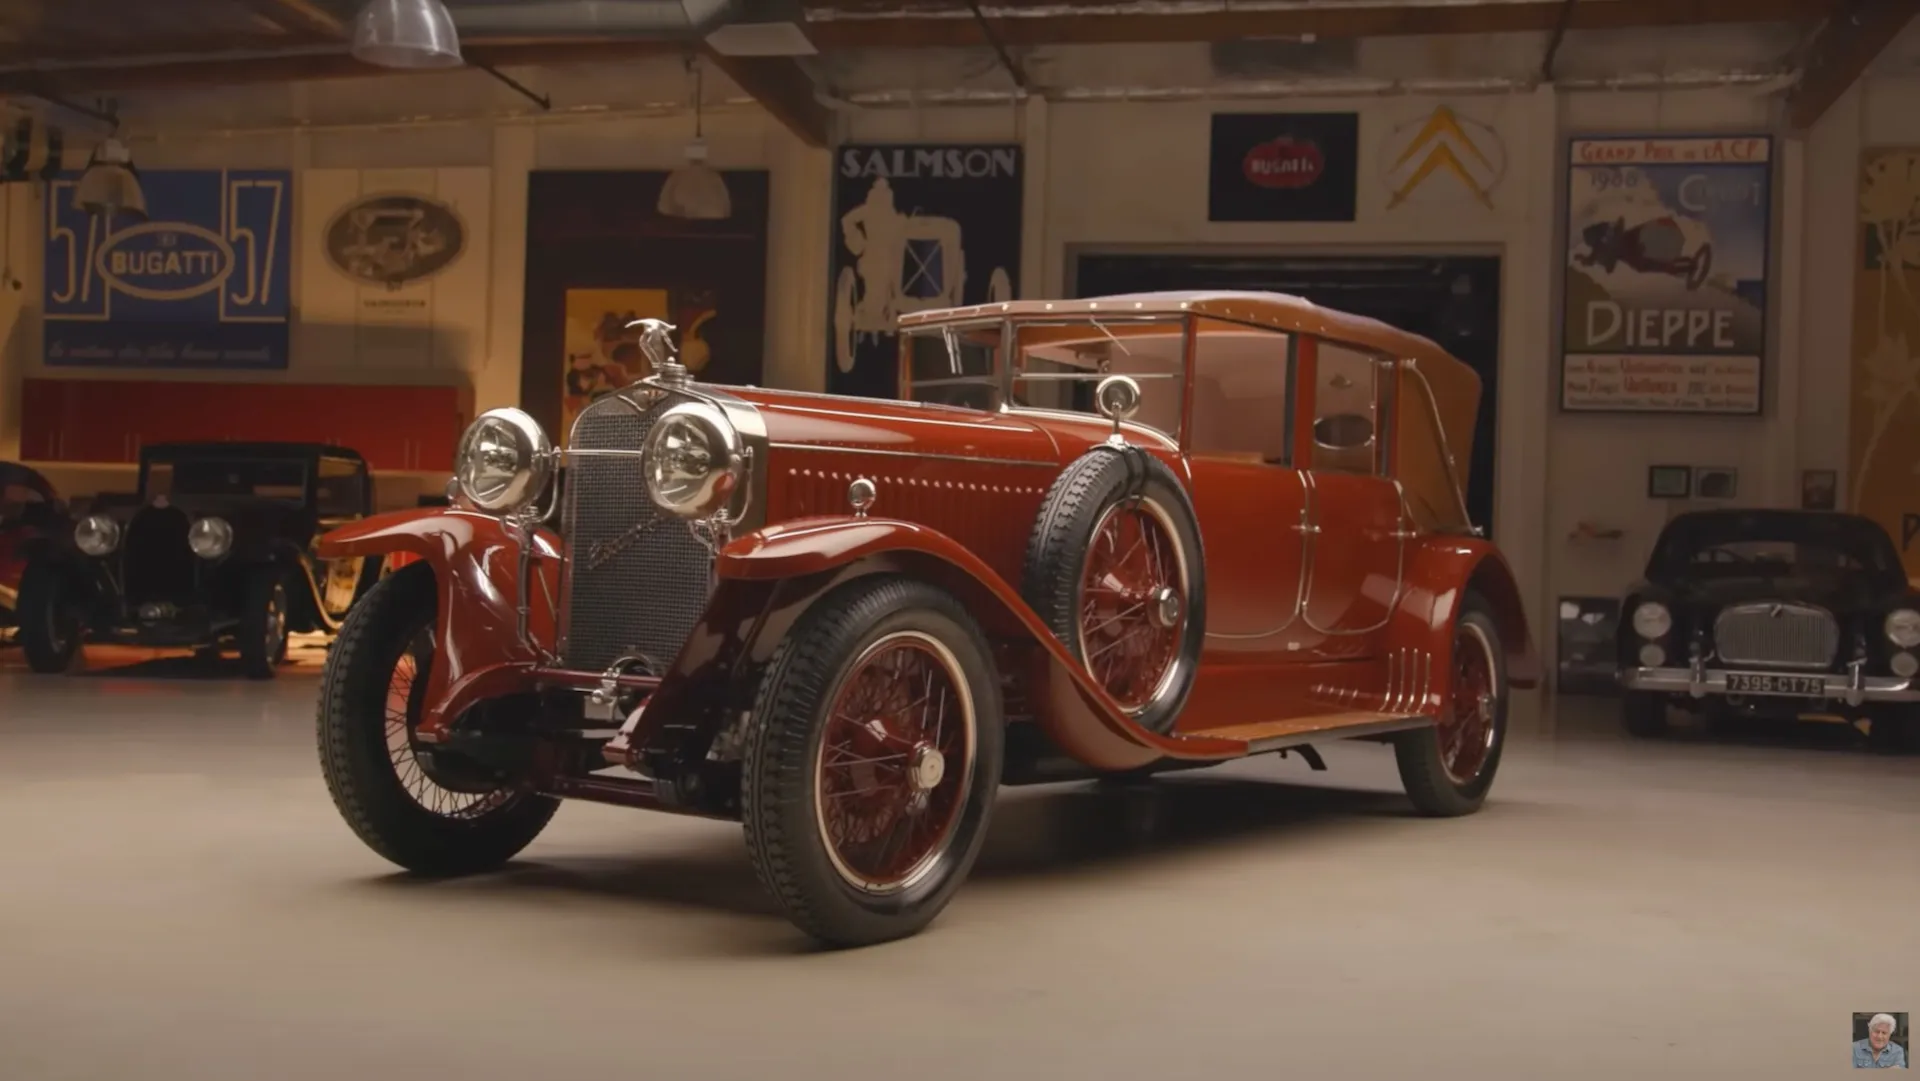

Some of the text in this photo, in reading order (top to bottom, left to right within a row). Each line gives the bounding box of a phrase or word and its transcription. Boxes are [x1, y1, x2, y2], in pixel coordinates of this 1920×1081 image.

[840, 147, 1016, 179] SALMSON
[1580, 142, 1637, 161] GRAND
[229, 180, 283, 306] 57
[111, 250, 218, 276] BUGATTI
[1586, 300, 1735, 348] DIEPPE
